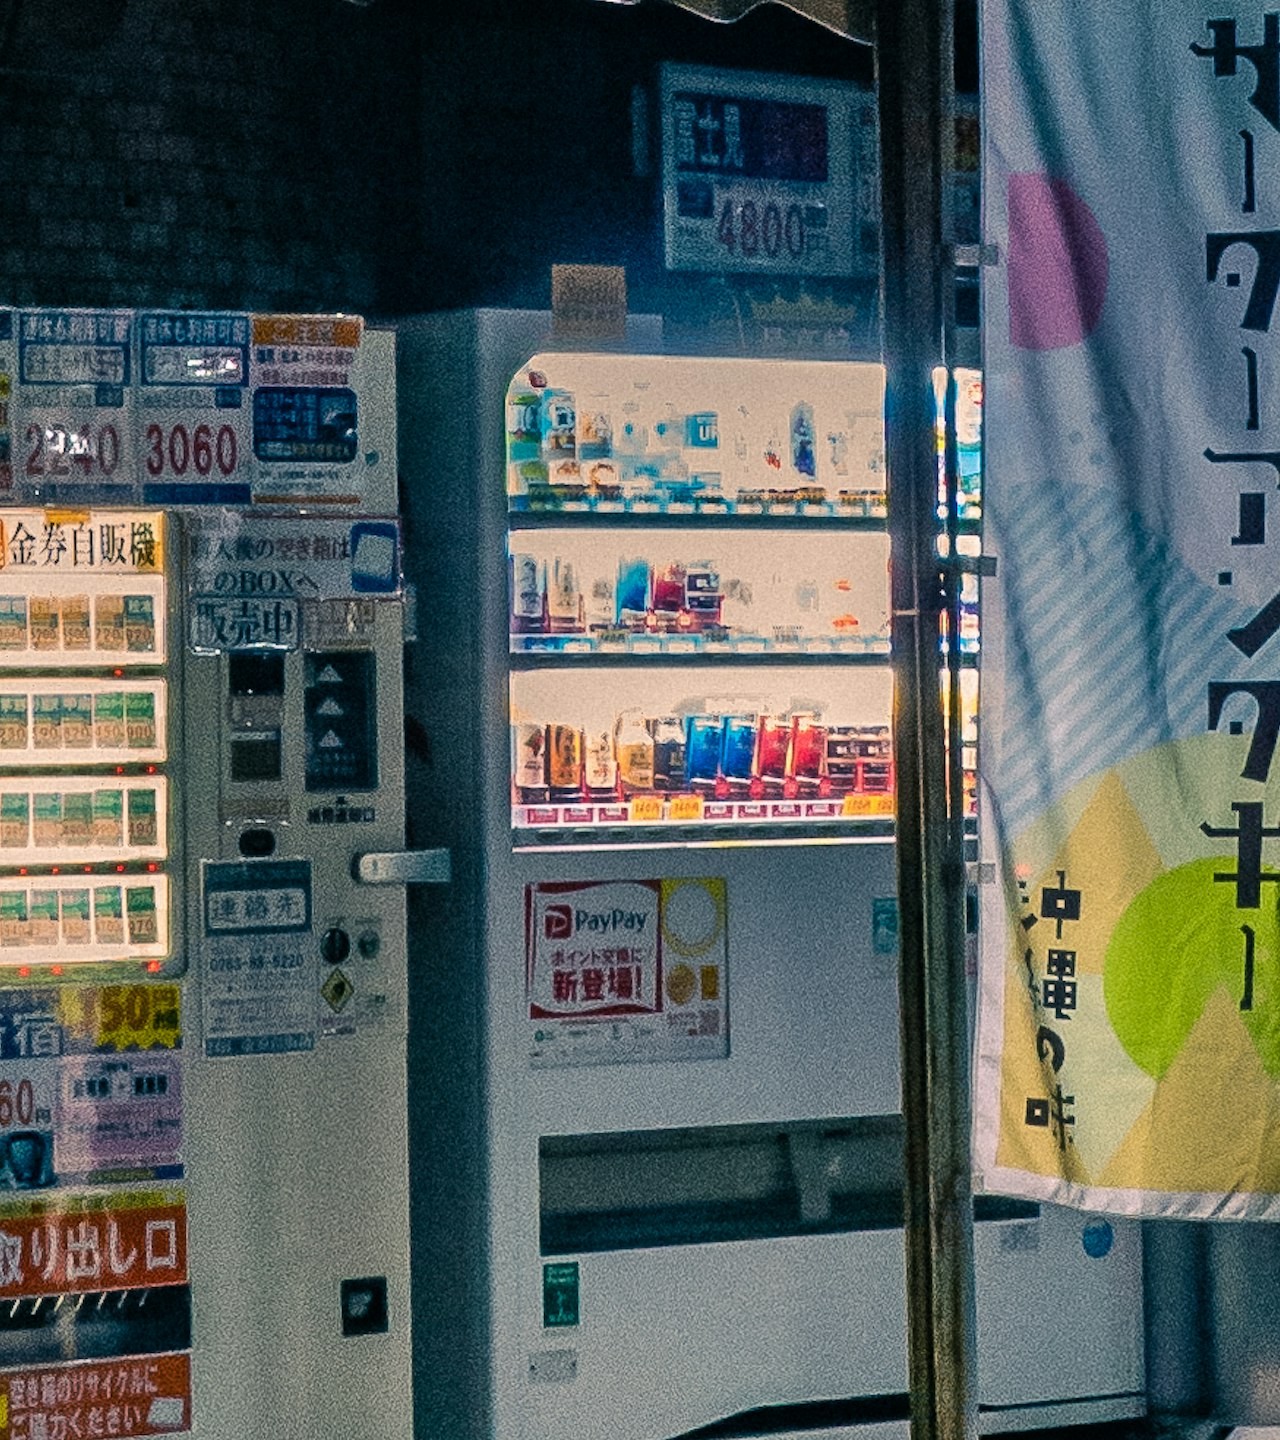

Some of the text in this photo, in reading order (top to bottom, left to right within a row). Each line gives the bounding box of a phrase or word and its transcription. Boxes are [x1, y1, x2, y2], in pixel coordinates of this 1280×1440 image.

[146, 423, 238, 476] 3060
[8, 520, 157, 568] 金券自販機
[192, 567, 321, 593] のBOXへ
[195, 600, 293, 645] 販売中
[211, 893, 302, 924] 連絡先
[575, 909, 651, 933] PayPay
[9, 1364, 159, 1410] 空き箱のリサイクルに
